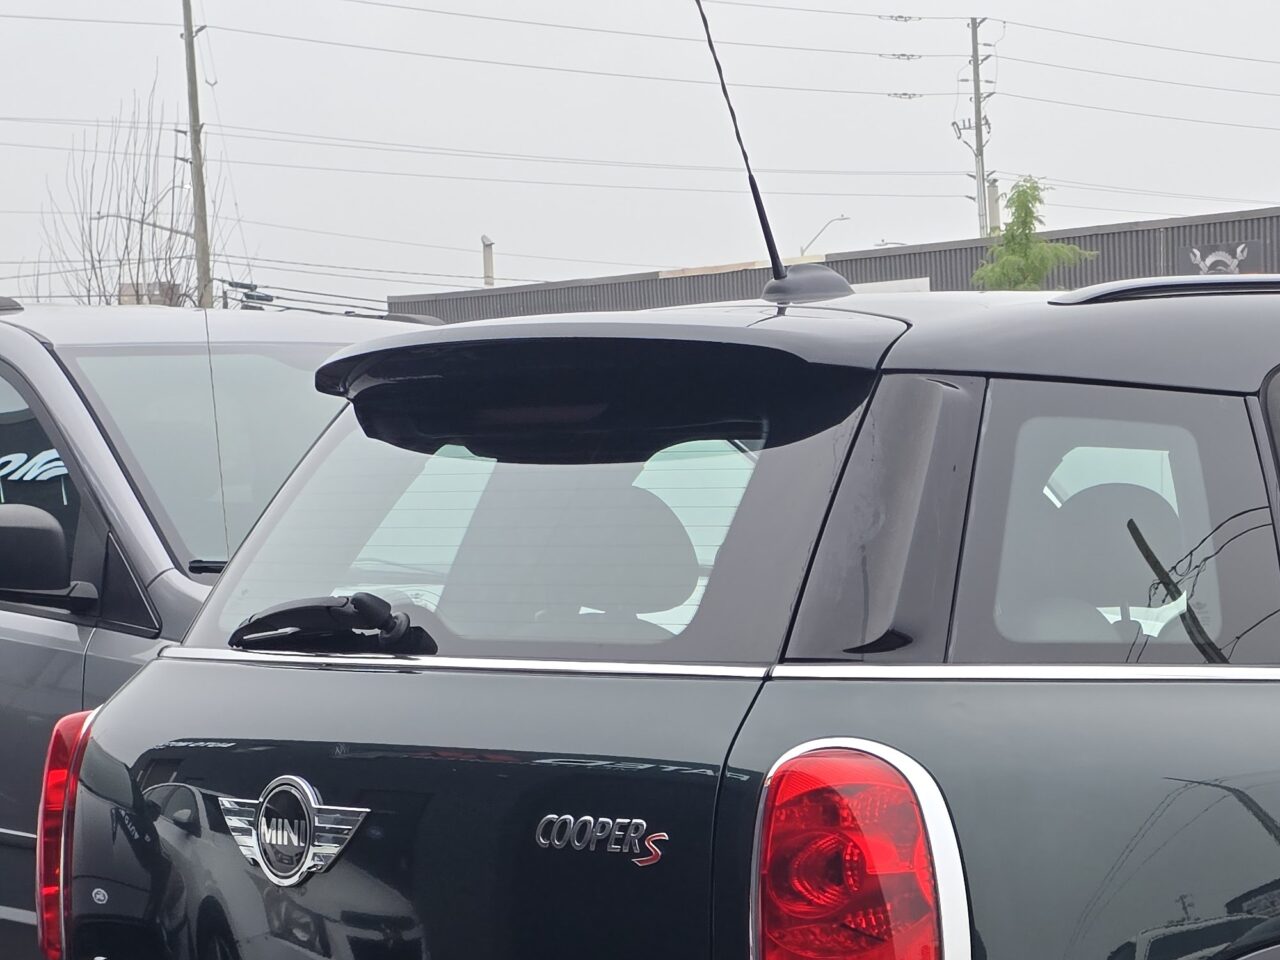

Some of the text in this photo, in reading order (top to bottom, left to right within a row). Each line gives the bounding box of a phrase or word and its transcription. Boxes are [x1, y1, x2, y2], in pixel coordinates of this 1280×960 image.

[261, 816, 306, 847] MINI
[535, 814, 669, 867] COOPER S
